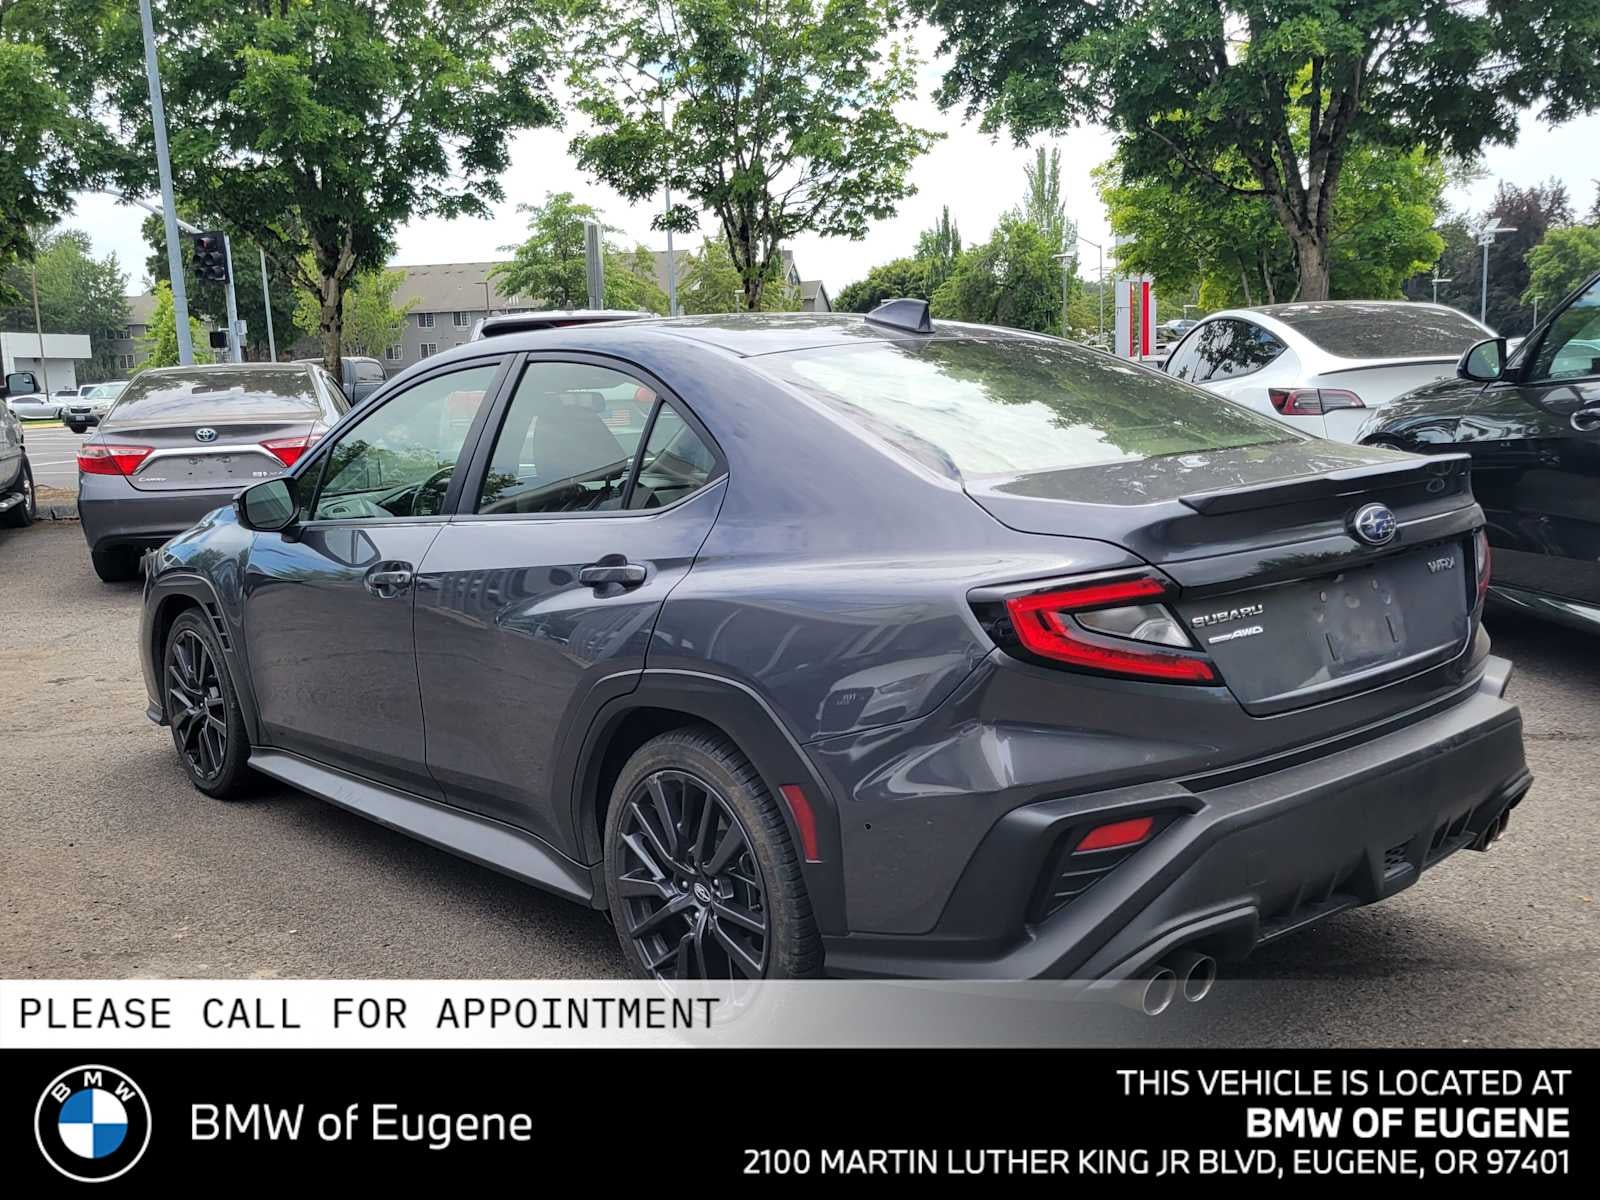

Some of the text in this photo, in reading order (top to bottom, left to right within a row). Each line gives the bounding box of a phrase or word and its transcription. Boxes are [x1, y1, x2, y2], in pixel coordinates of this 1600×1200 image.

[1427, 556, 1455, 573] WRX
[1191, 603, 1264, 628] SUBARU
[1231, 625, 1264, 639] AWD
